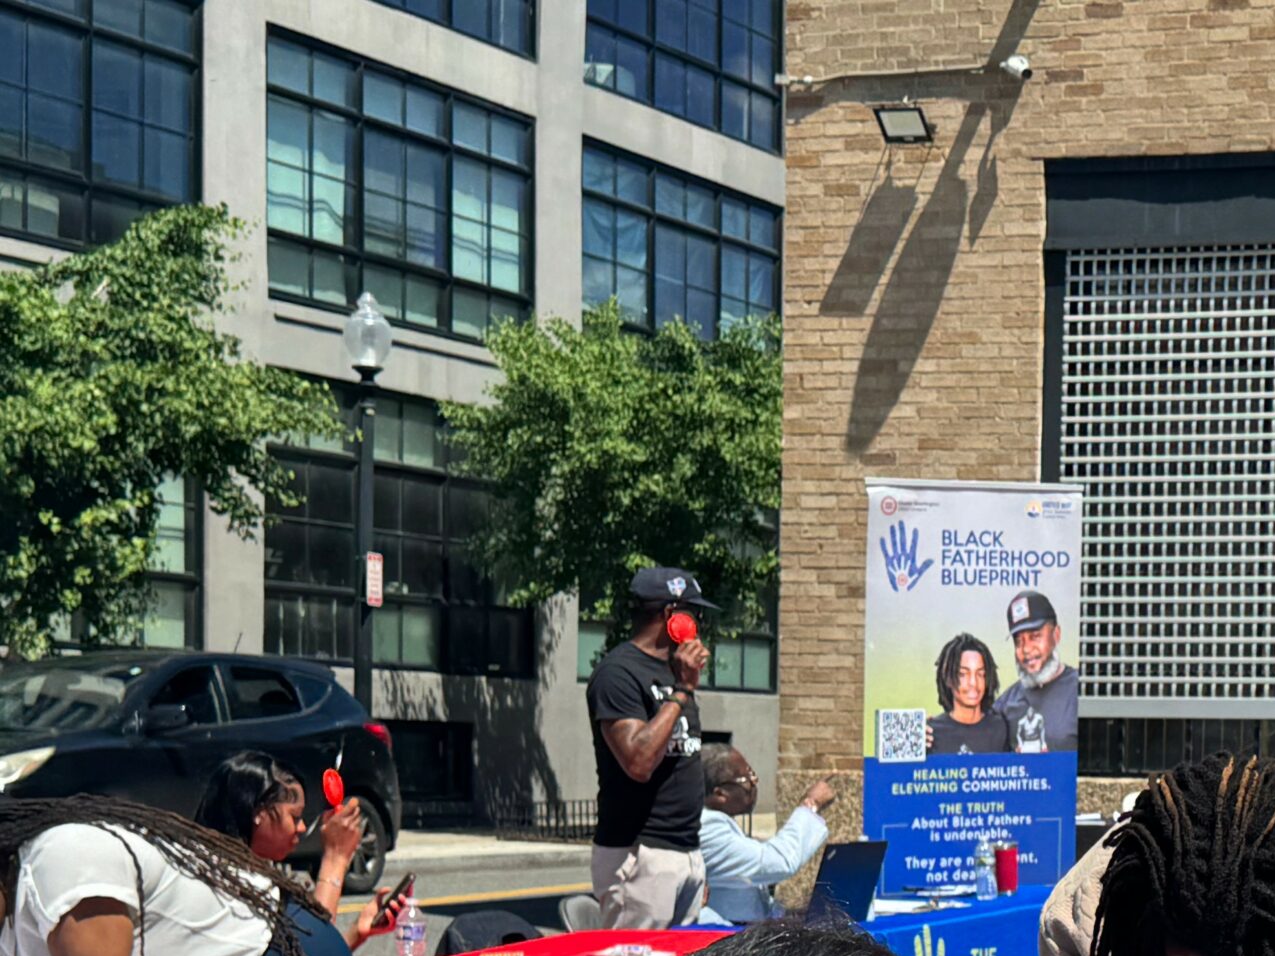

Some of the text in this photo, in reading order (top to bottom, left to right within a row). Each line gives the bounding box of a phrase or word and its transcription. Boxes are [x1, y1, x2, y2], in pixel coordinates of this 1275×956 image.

[941, 529, 1004, 548] BLACK
[941, 549, 1070, 568] FATHERHOOD
[941, 568, 1042, 587] BLUEPRINT
[913, 765, 1029, 781] HEALING FAMILIES.
[891, 779, 1051, 796] ELEVATING COMMUNITIES.
[938, 801, 1005, 815] THE TRUTH
[911, 813, 1032, 830] About Black Fathers
[930, 830, 941, 843] is
[904, 856, 936, 871] They
[939, 857, 963, 868] are
[926, 871, 948, 883] not
